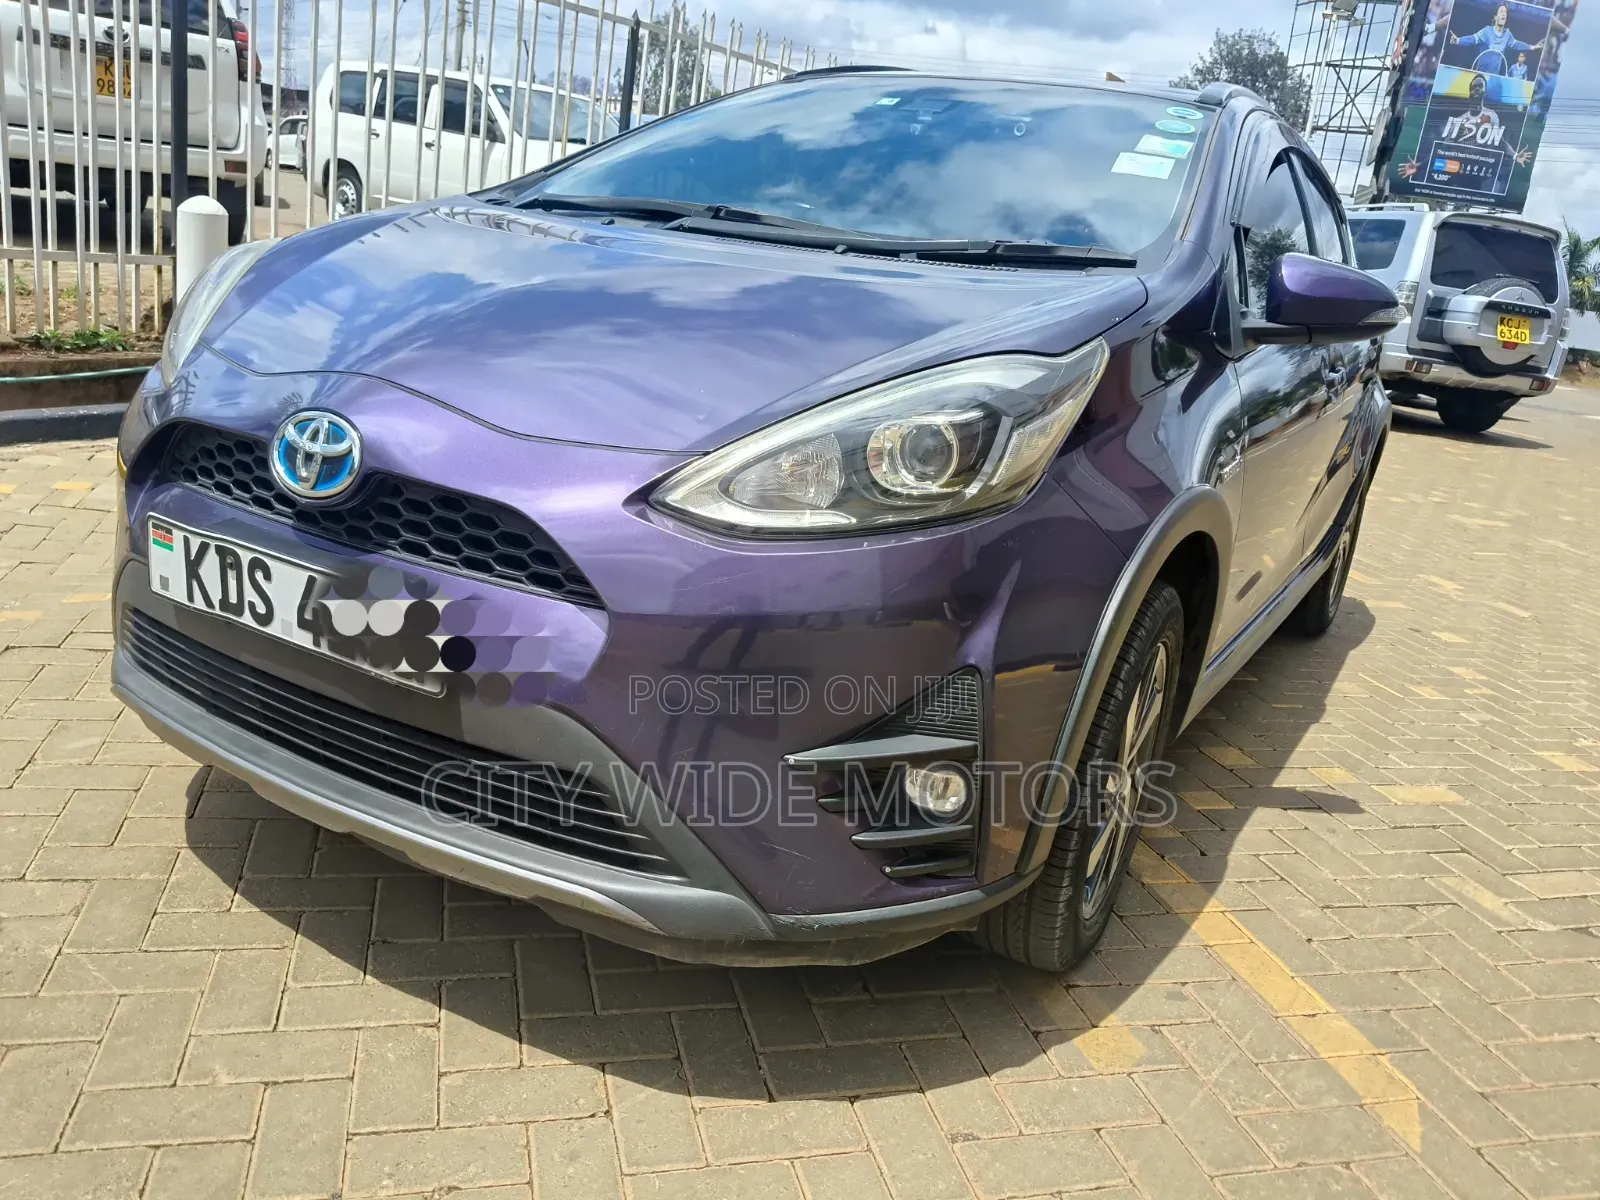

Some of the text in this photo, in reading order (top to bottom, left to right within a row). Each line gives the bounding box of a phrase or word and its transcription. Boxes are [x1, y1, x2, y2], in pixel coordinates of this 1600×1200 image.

[1441, 116, 1505, 146] IT'S ON
[1500, 316, 1521, 330] KCJ
[1499, 329, 1527, 342] 634D
[182, 533, 275, 627] KDS
